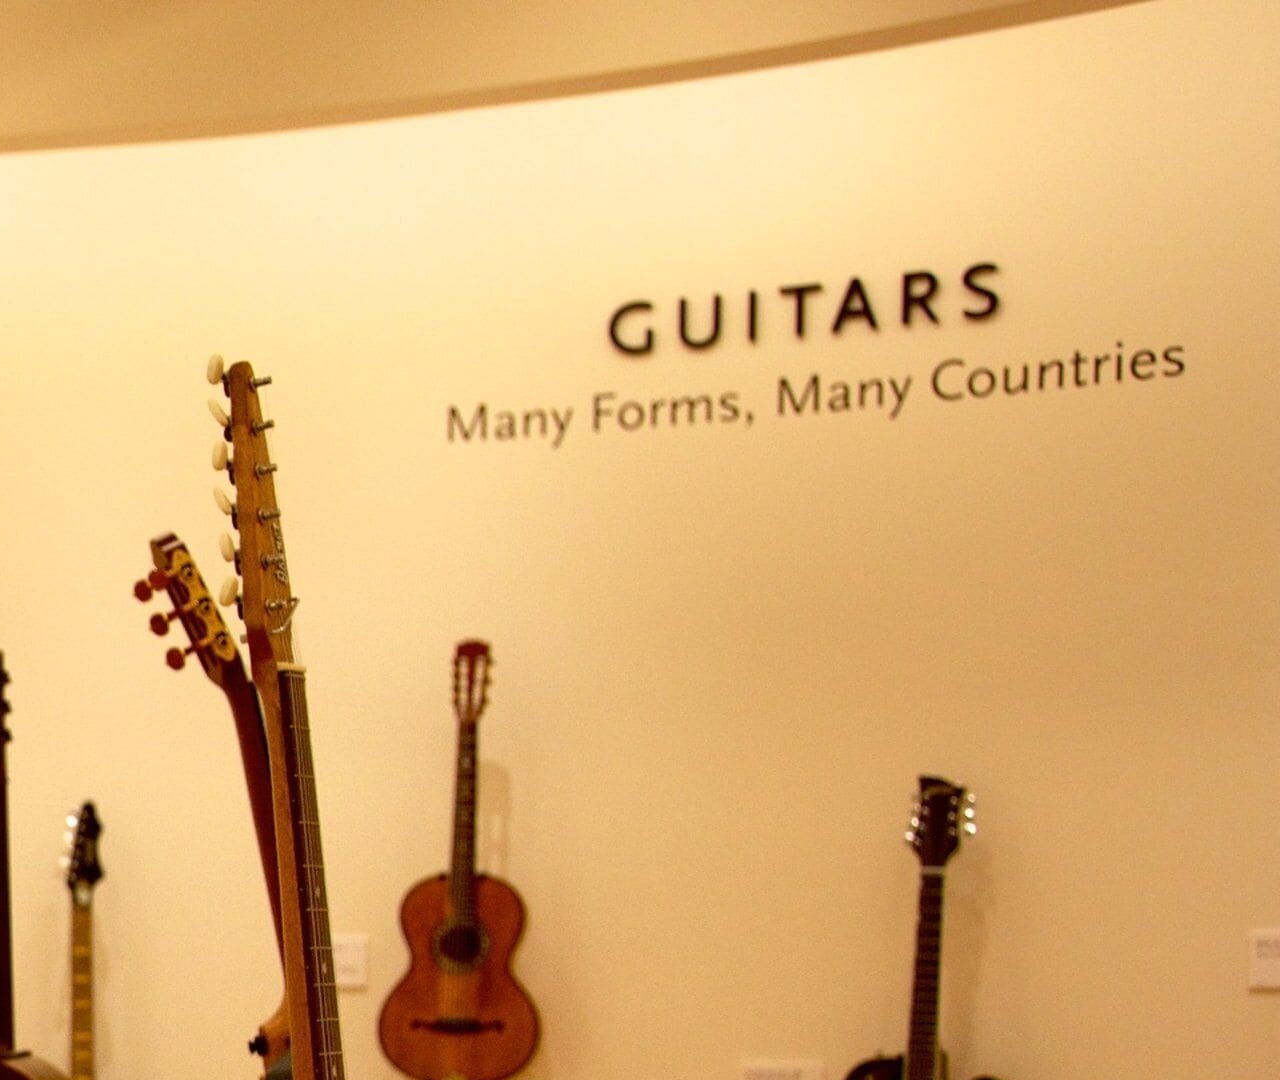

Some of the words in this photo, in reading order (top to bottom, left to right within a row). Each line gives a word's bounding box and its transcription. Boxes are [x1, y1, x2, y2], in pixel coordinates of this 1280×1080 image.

[608, 262, 1002, 360] GUITARS
[447, 402, 573, 449] Many
[592, 392, 754, 432] Forms,
[778, 374, 912, 420] Many
[930, 341, 1187, 402] Countries
